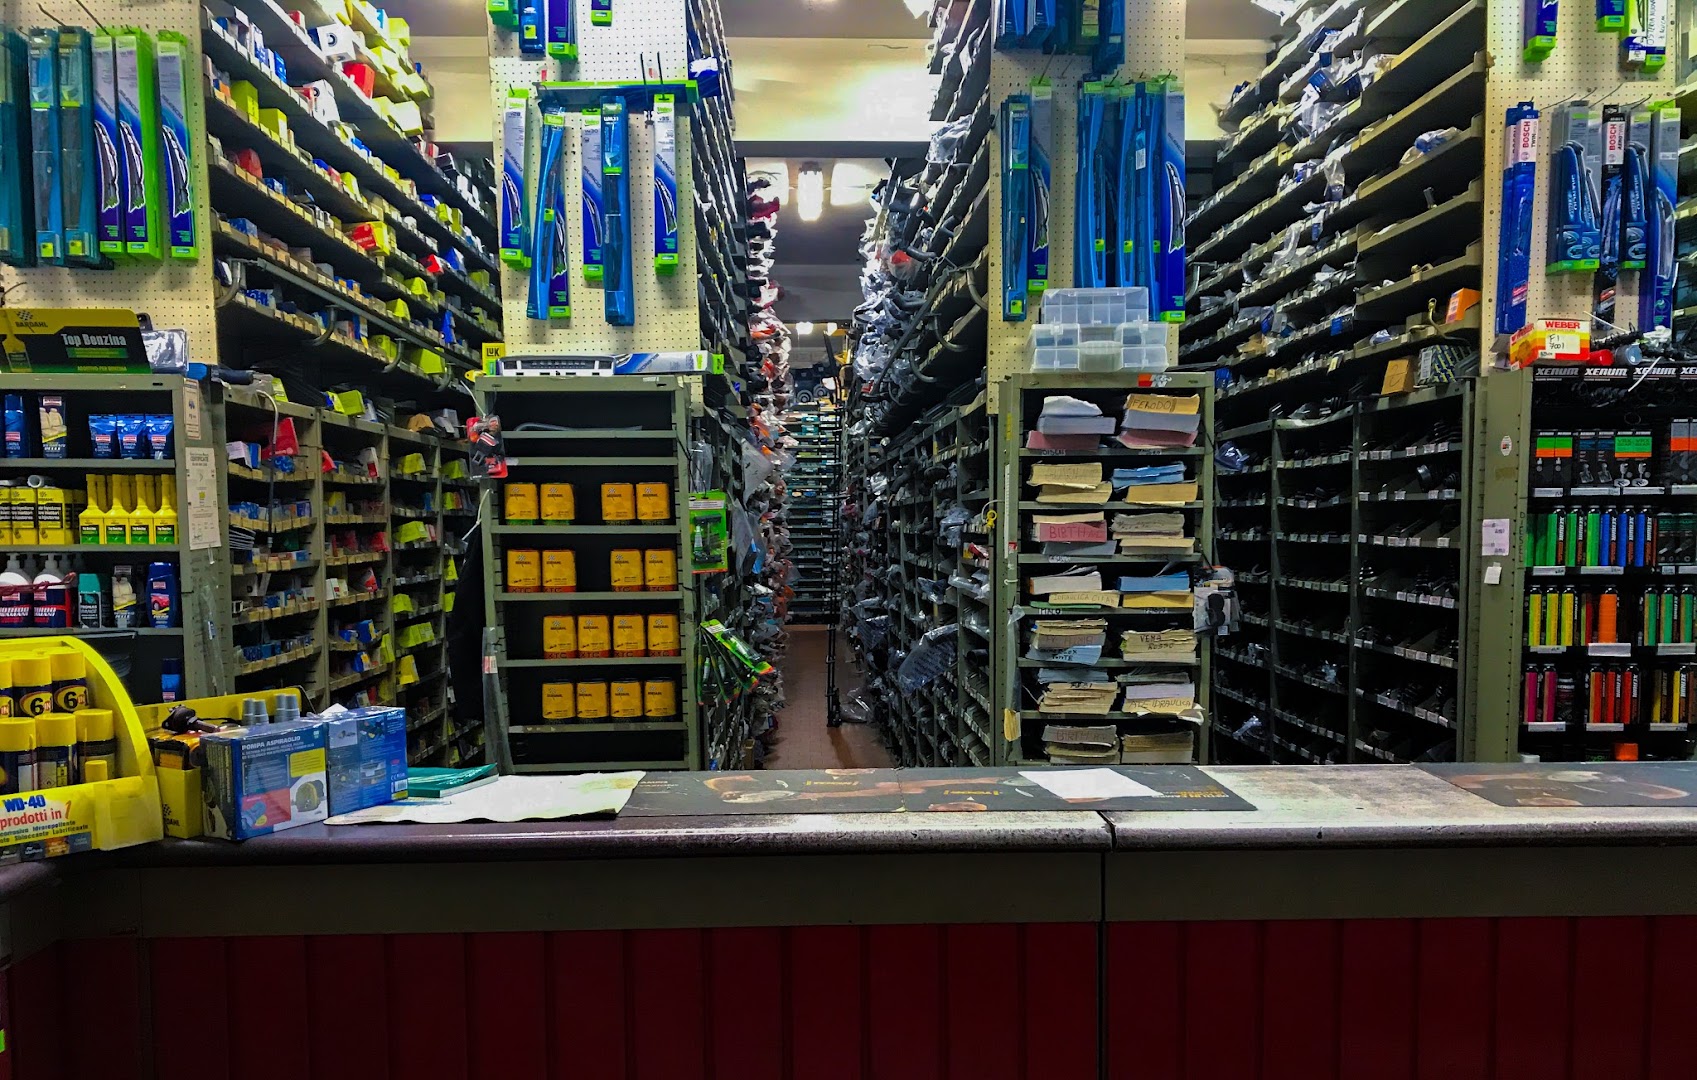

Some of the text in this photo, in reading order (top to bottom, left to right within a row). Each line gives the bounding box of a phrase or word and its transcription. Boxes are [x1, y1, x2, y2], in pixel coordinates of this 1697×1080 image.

[1523, 121, 1531, 148] BOSCH
[1609, 124, 1617, 151] BOSCH
[15, 321, 48, 329] BARDAHL
[1545, 321, 1580, 329] WEBER
[61, 333, 127, 347] Top Benzina
[1535, 367, 1579, 375] XENUM
[1584, 367, 1628, 376] XENUM
[30, 697, 44, 715] 6
[64, 691, 78, 708] 6
[242, 741, 265, 750] POMPA
[3, 794, 46, 812] WD-40
[0, 800, 72, 830] prodotti in 1
